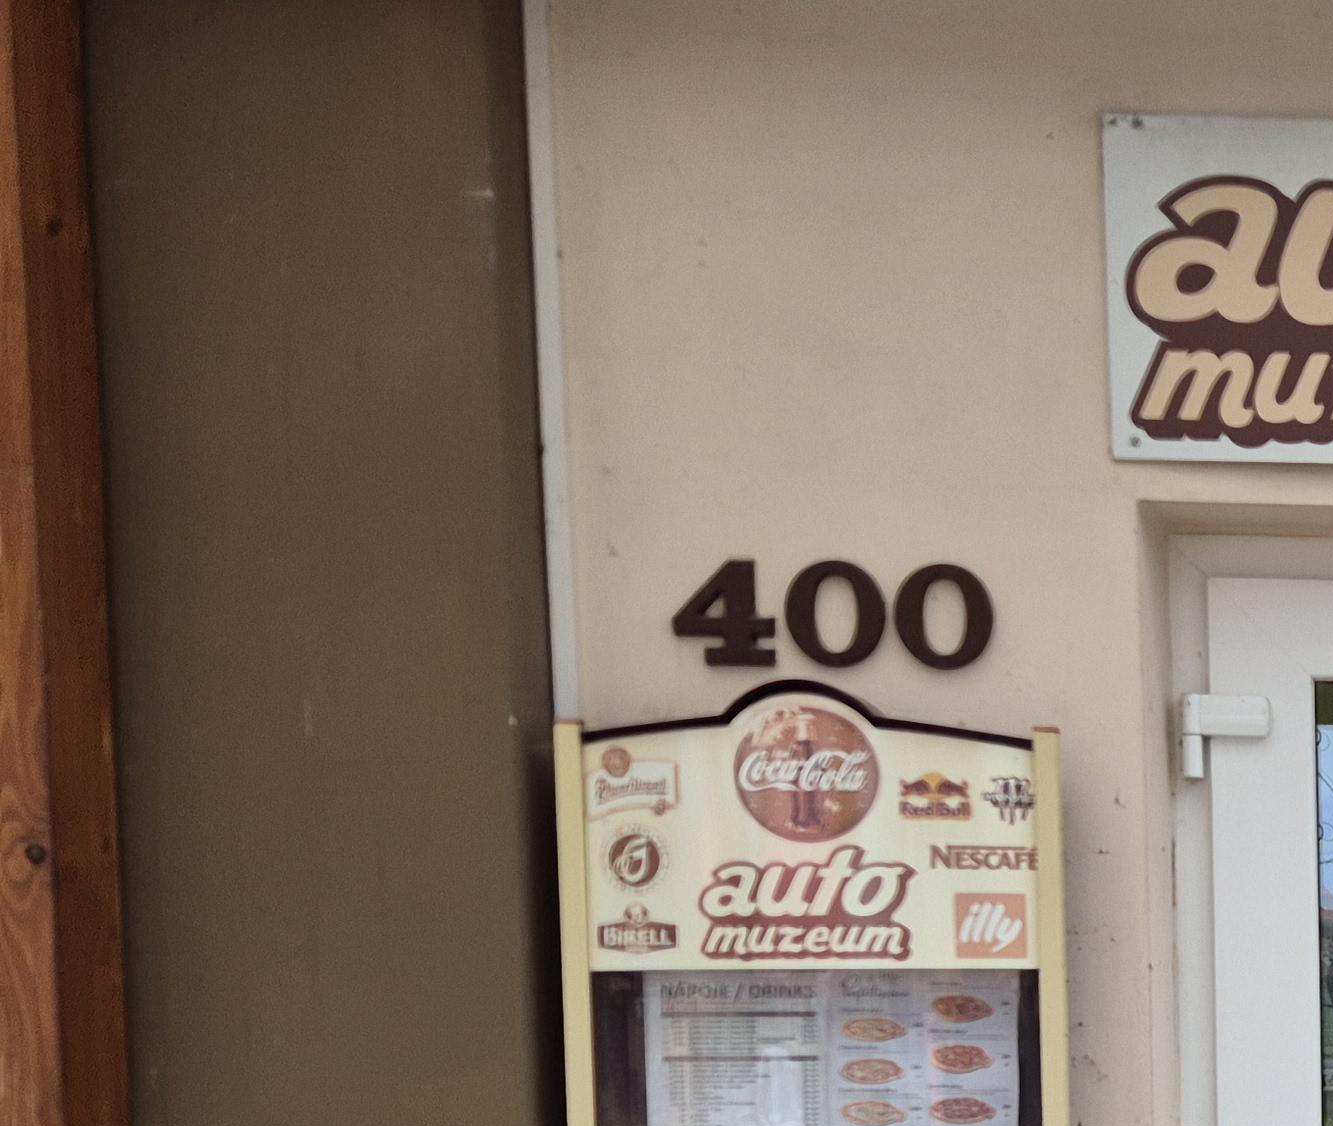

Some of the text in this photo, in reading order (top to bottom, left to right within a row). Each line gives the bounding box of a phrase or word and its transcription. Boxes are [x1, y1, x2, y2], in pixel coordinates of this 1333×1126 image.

[672, 559, 994, 670] 400
[901, 801, 971, 817] Red Bull
[700, 846, 913, 917] auto
[602, 925, 675, 947] BIRELL
[703, 923, 906, 956] muzeum
[959, 901, 1024, 953] illy
